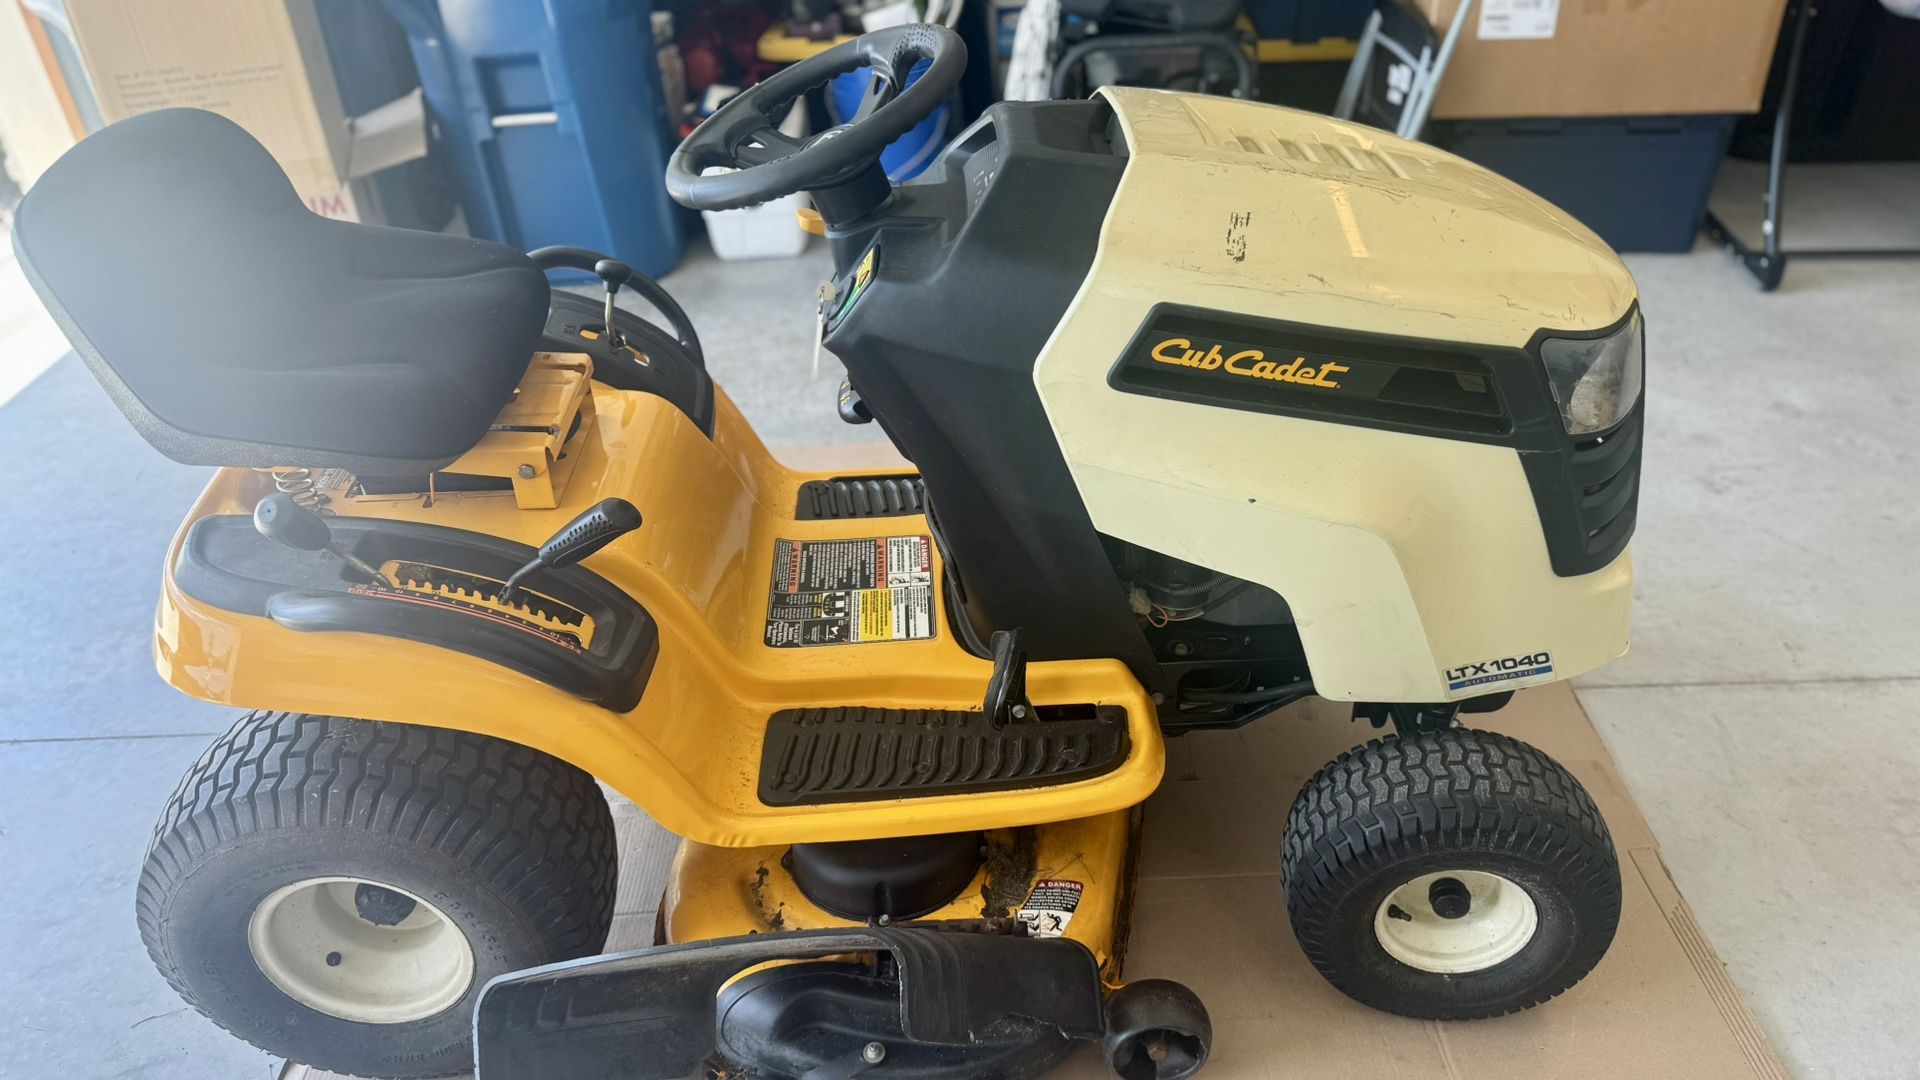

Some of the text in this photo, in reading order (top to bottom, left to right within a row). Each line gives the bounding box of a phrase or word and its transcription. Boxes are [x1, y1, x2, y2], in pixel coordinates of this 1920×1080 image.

[1151, 338, 1350, 388] Cub Cadet
[921, 544, 929, 568] DANGER
[789, 553, 798, 586] WARNING
[1446, 652, 1550, 681] LTX 1040
[1464, 669, 1536, 686] AUTOMATIC
[1047, 881, 1081, 890] DANGER
